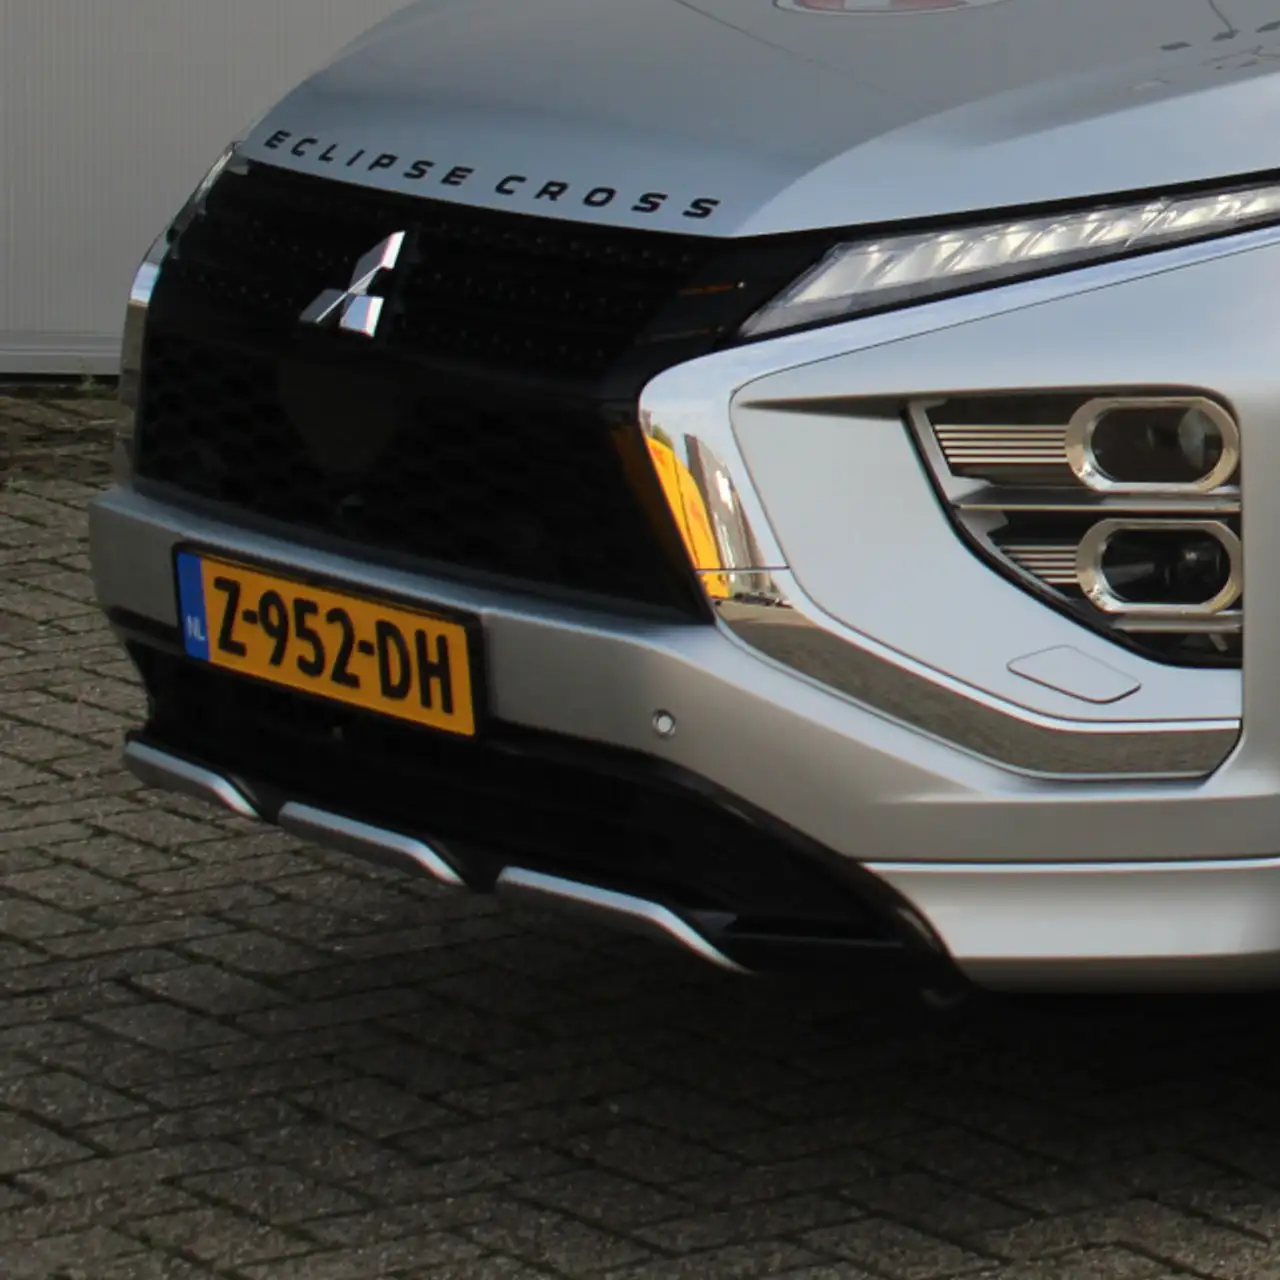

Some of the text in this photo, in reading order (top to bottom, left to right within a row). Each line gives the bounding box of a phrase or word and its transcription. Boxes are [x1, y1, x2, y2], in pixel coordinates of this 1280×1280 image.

[264, 130, 721, 220] ECLIPSE CROSS
[213, 575, 456, 716] Z-952-DH
